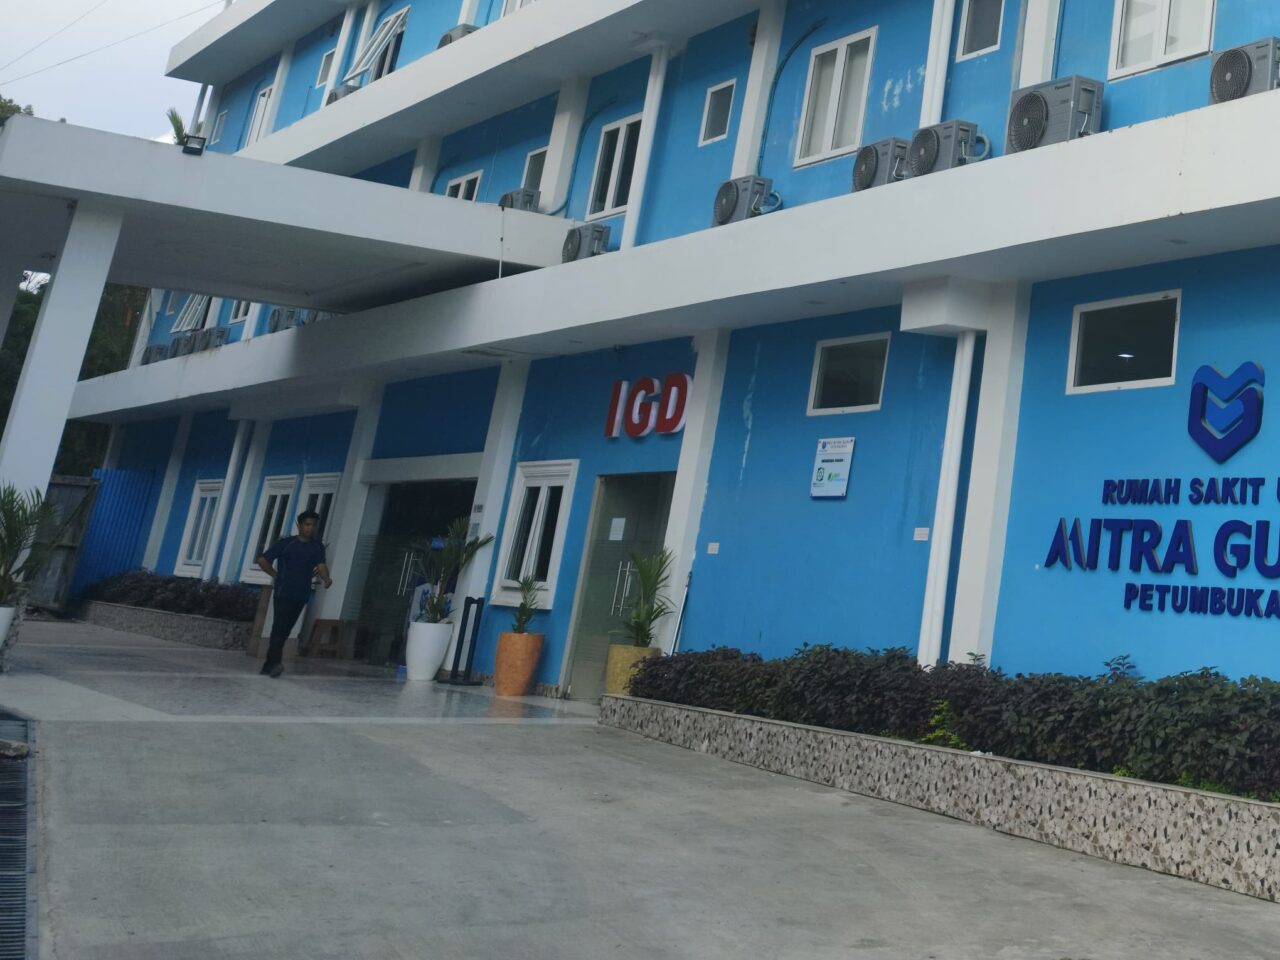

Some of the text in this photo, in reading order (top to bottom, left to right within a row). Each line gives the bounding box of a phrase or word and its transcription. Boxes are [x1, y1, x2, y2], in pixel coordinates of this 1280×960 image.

[605, 372, 694, 438] IGD
[1102, 478, 1181, 506] RUMAH
[1189, 477, 1266, 506] SAKIT
[1044, 517, 1199, 576] MITRA
